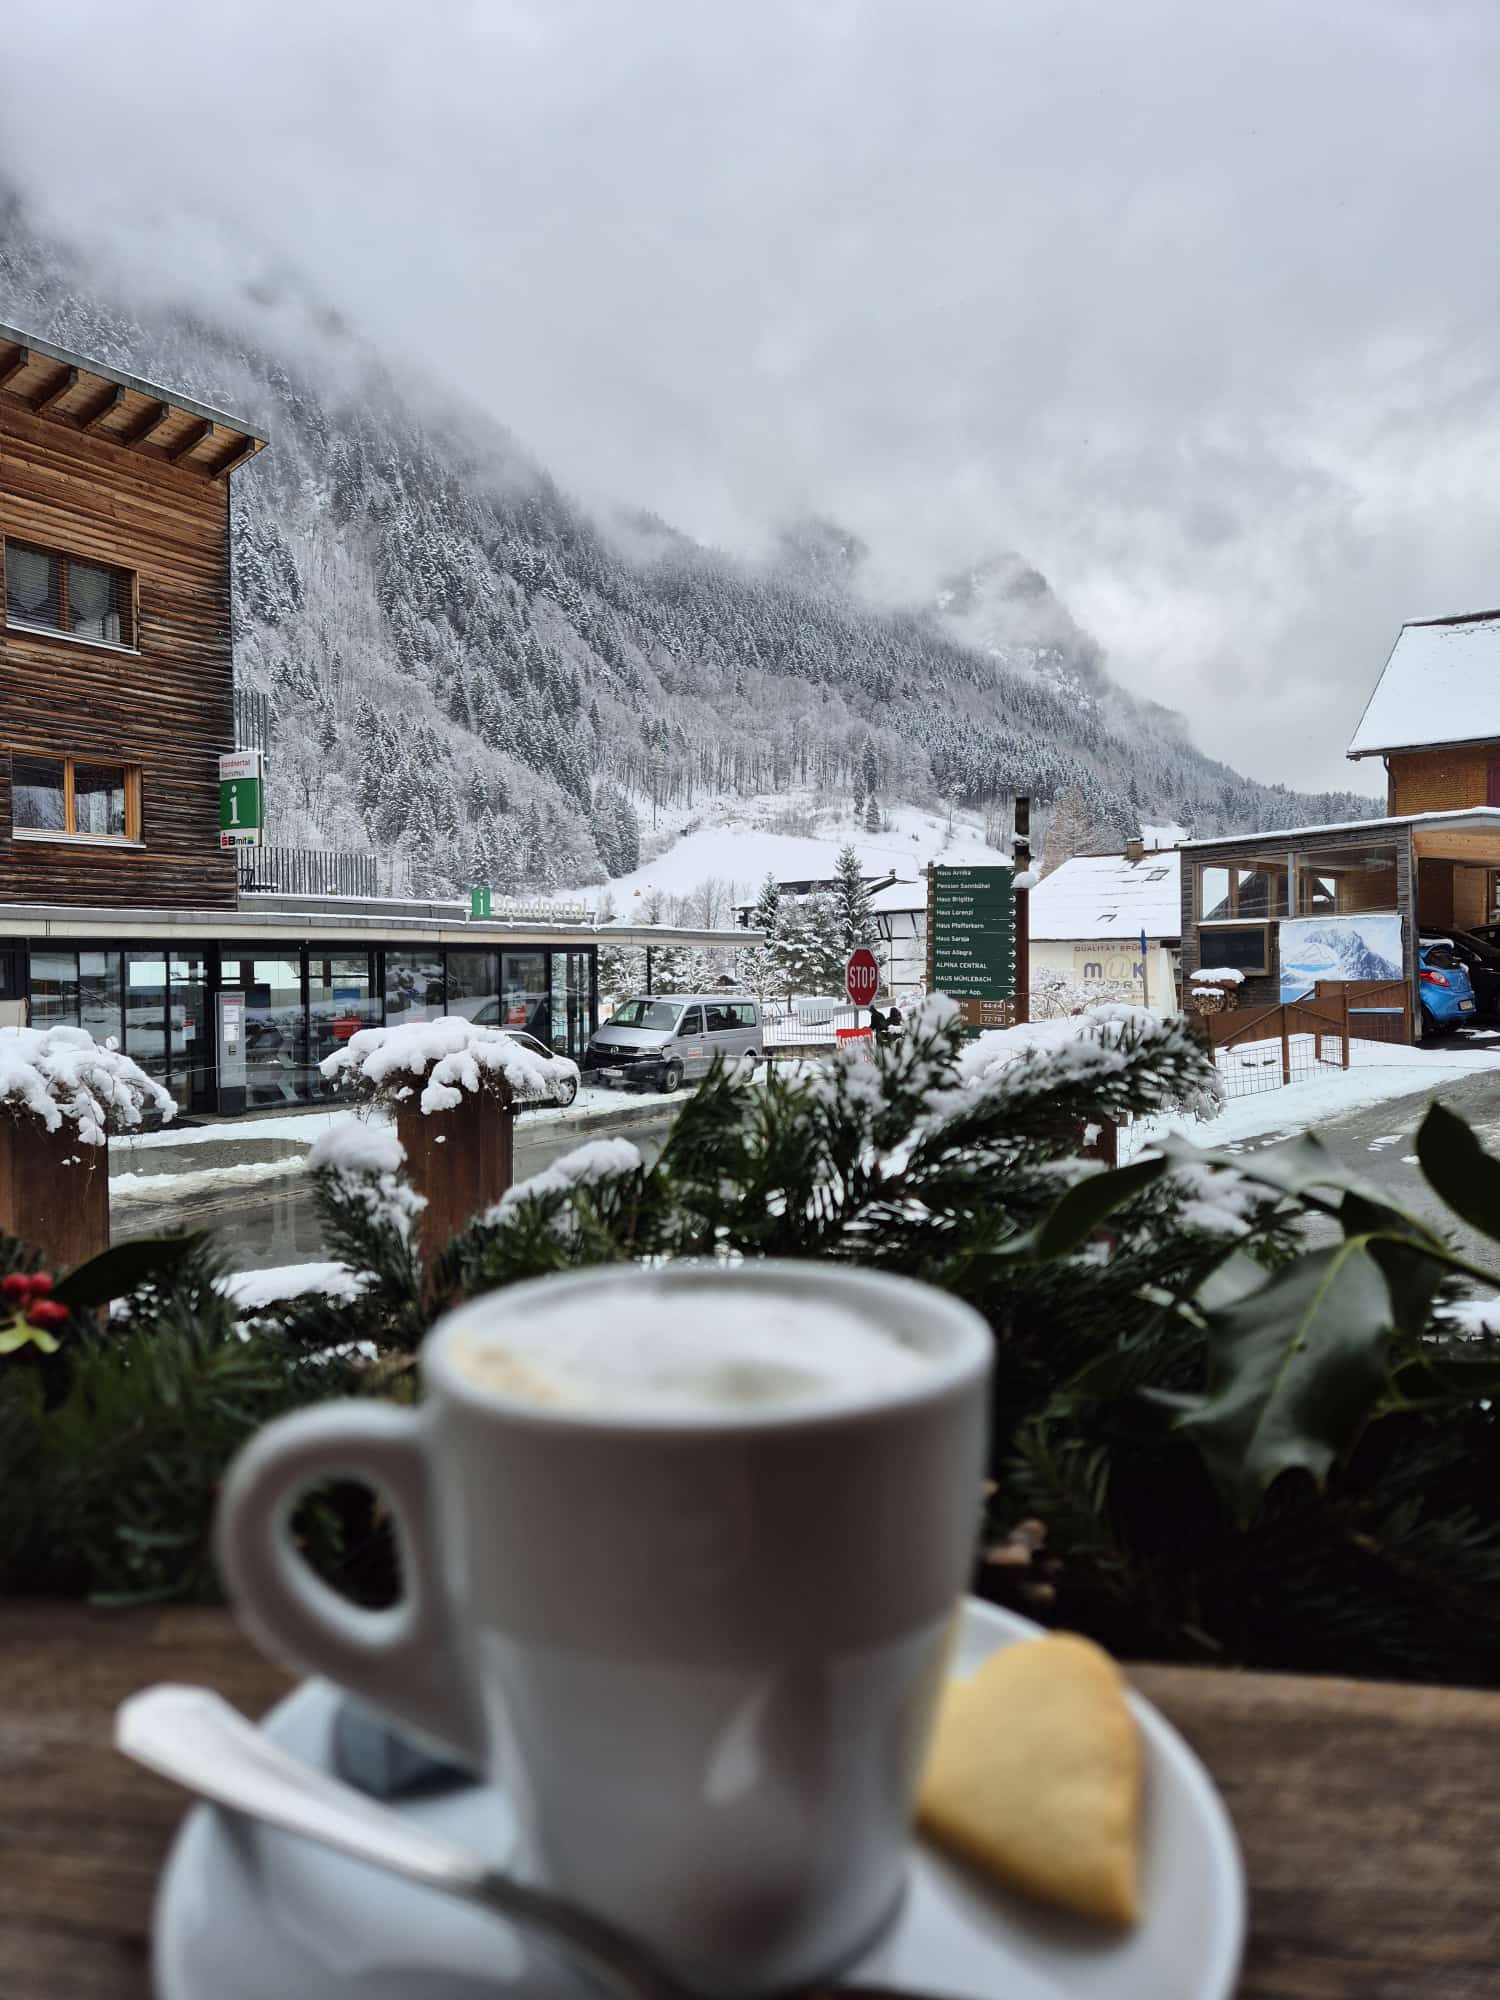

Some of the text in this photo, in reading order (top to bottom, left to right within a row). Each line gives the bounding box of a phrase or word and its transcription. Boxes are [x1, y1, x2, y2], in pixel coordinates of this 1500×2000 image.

[952, 949, 973, 957] Allegra
[850, 966, 876, 988] STOP
[953, 974, 992, 982] MÜHLEBACH
